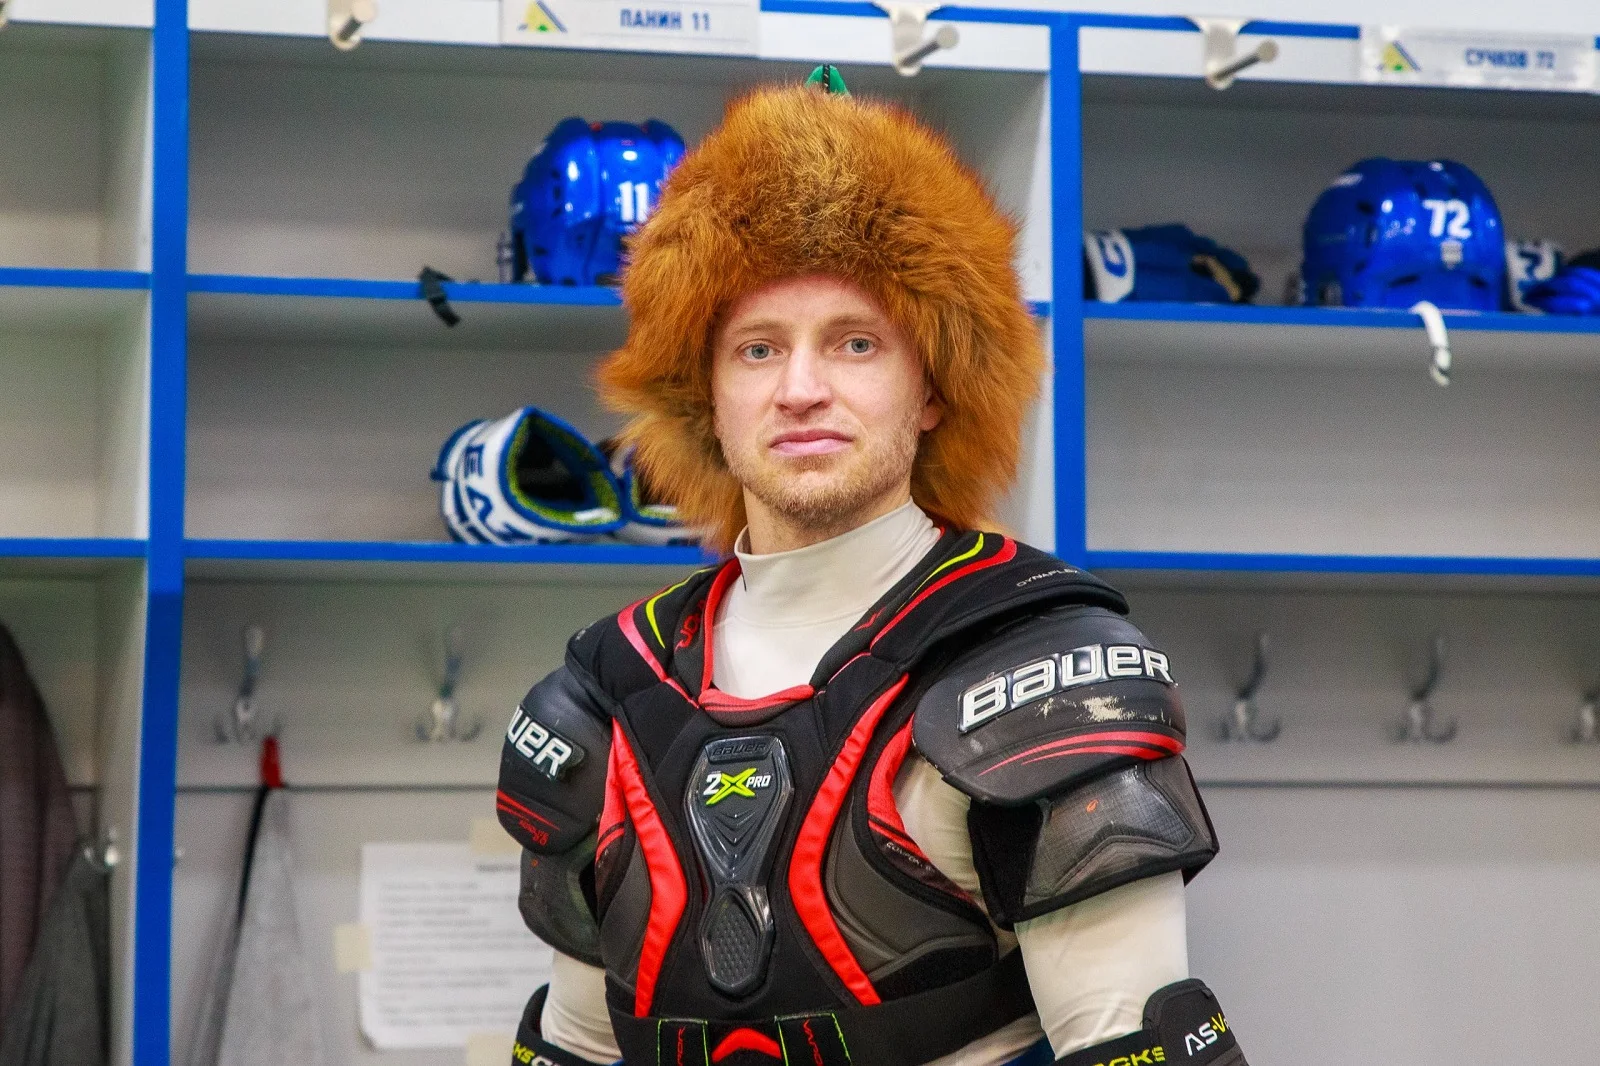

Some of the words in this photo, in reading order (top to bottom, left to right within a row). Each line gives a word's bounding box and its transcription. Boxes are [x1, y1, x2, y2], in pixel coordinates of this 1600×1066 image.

[620, 8, 682, 30] ПАНИН
[692, 12, 710, 31] 11
[618, 181, 649, 223] 11
[1422, 199, 1472, 240] 72
[961, 644, 1174, 730] BAUER
